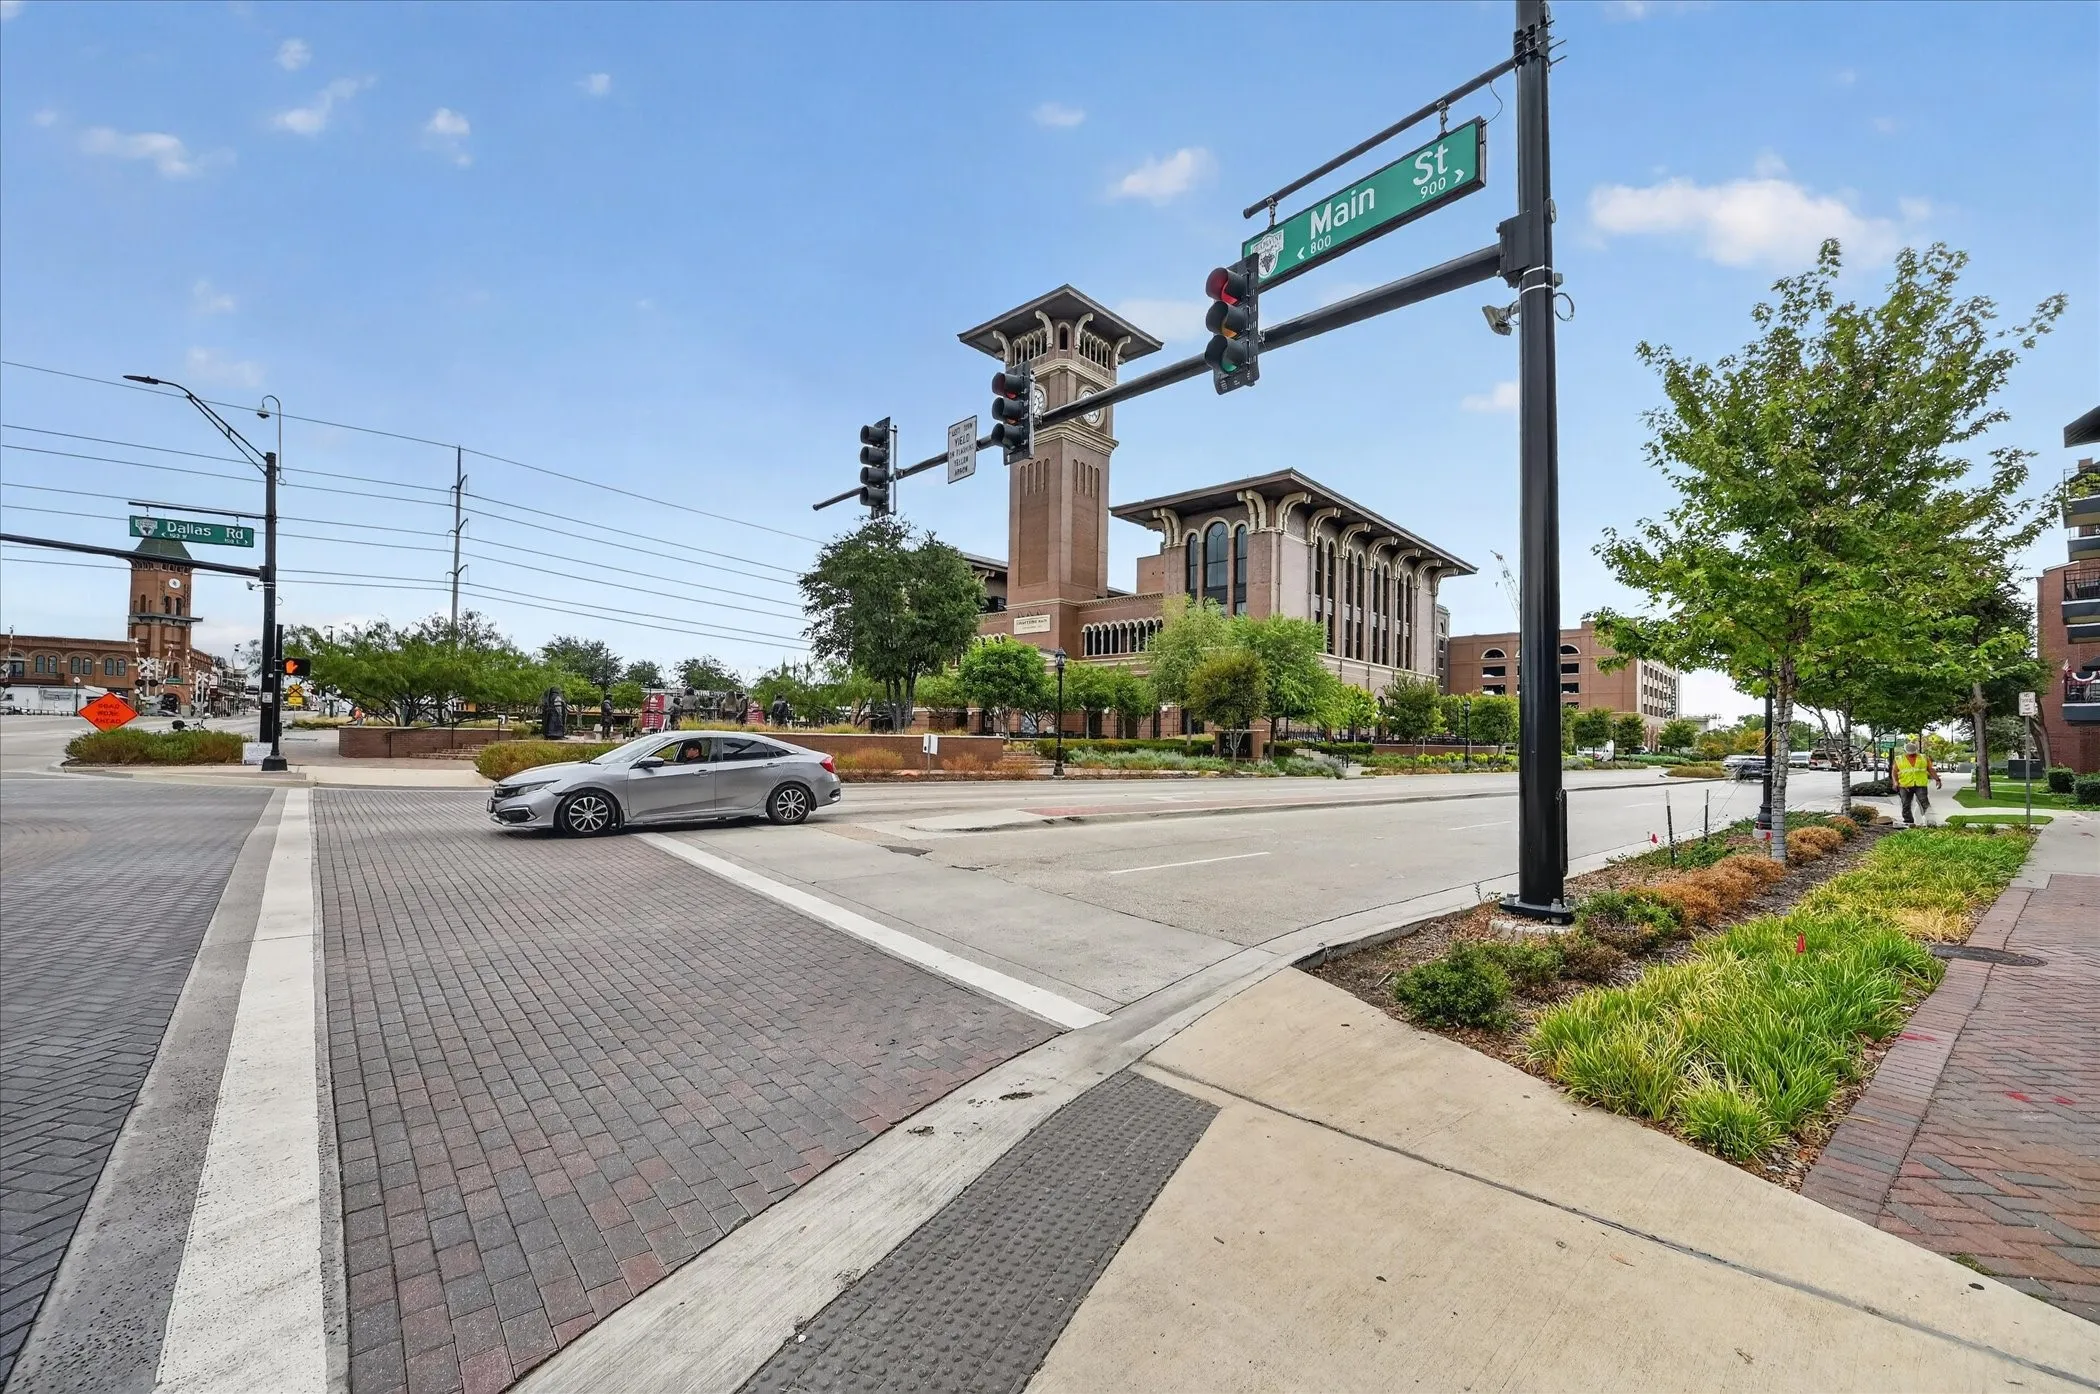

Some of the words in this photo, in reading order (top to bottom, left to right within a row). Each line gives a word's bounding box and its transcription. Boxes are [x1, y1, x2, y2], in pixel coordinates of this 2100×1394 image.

[1310, 187, 1375, 239] Main
[1413, 143, 1448, 186] St
[1420, 177, 1446, 199] 900
[1310, 235, 1331, 254] 800
[954, 433, 971, 447] YIELD
[167, 521, 212, 537] Dallas
[226, 527, 244, 540] Rd
